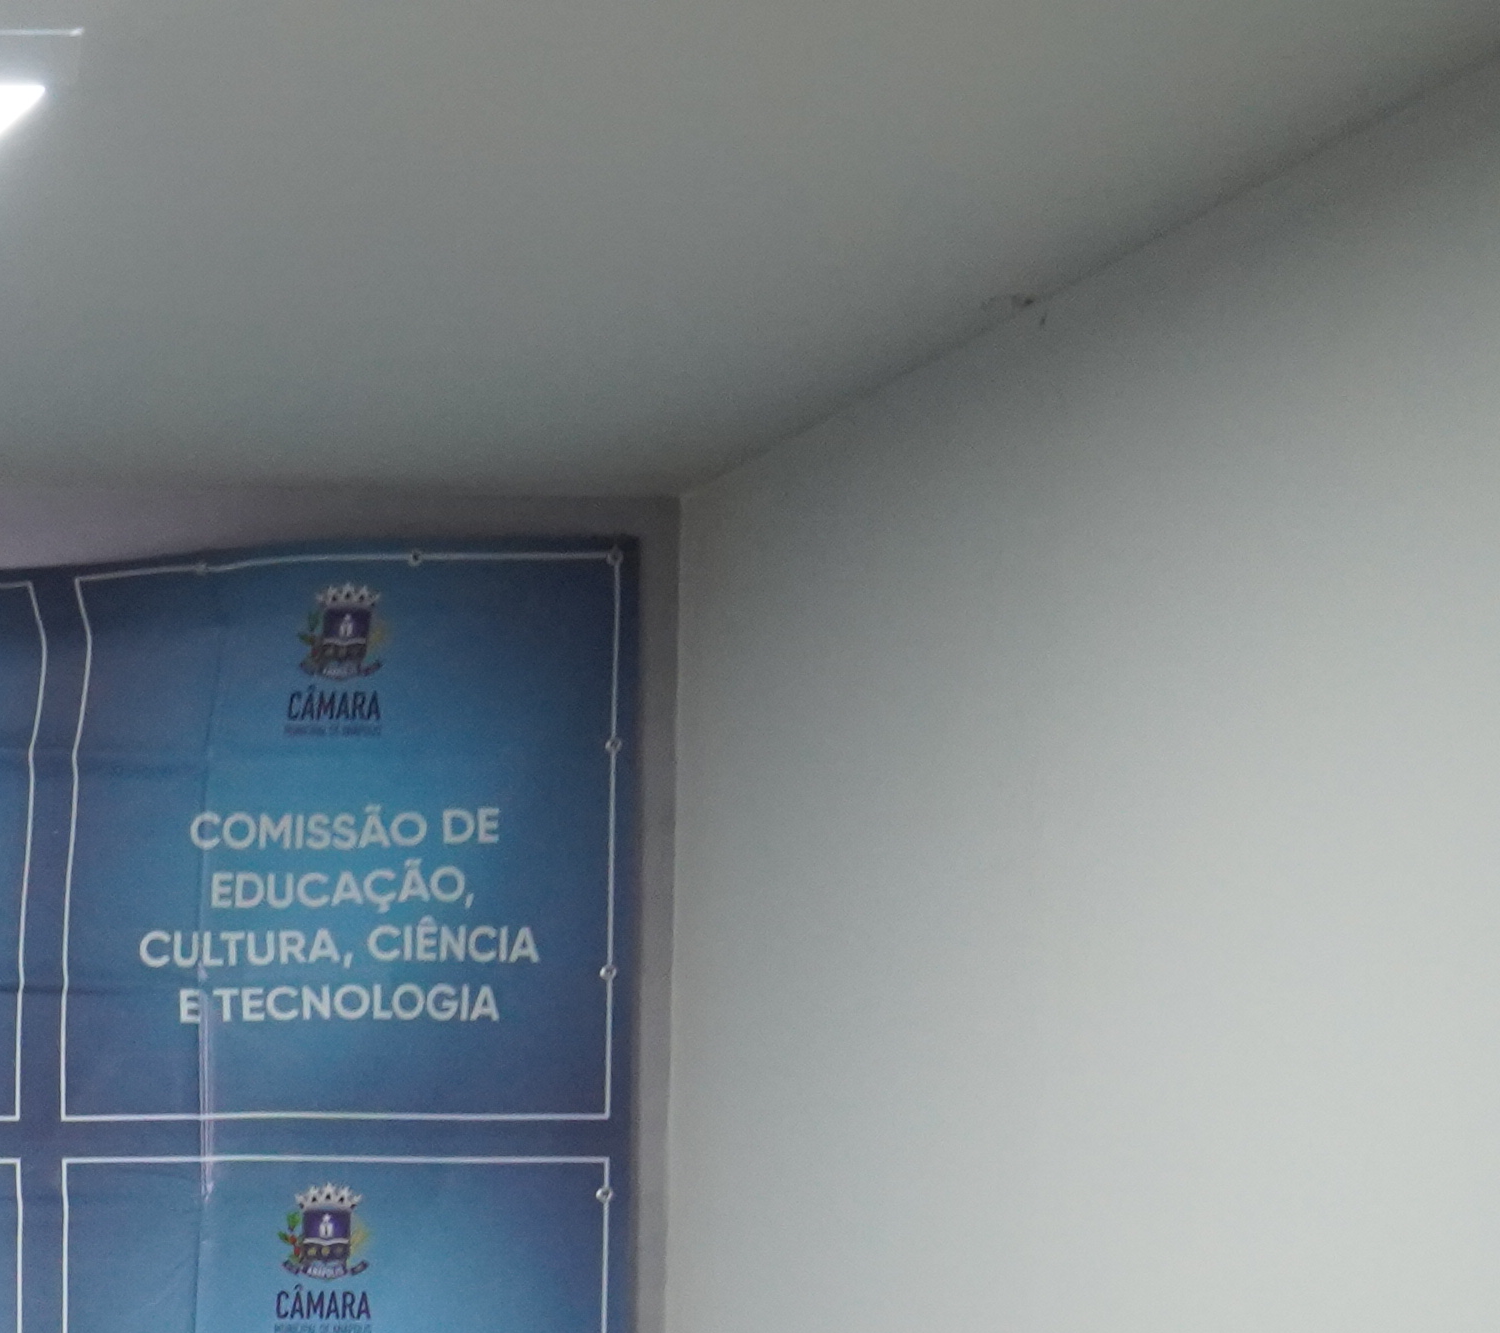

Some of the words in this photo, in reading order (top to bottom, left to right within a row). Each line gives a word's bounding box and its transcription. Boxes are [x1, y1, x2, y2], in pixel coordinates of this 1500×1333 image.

[287, 684, 381, 721] CÂMARA
[189, 804, 428, 850] COMISSÃO
[442, 807, 500, 845] DE
[210, 858, 475, 913] EDUCAÇÃO,
[139, 928, 353, 969] CULTURA,
[367, 915, 540, 964] CIÊNCIA
[179, 988, 200, 1024] E
[212, 984, 500, 1022] TECNOLOGIA
[275, 1283, 372, 1320] CÂMARA
